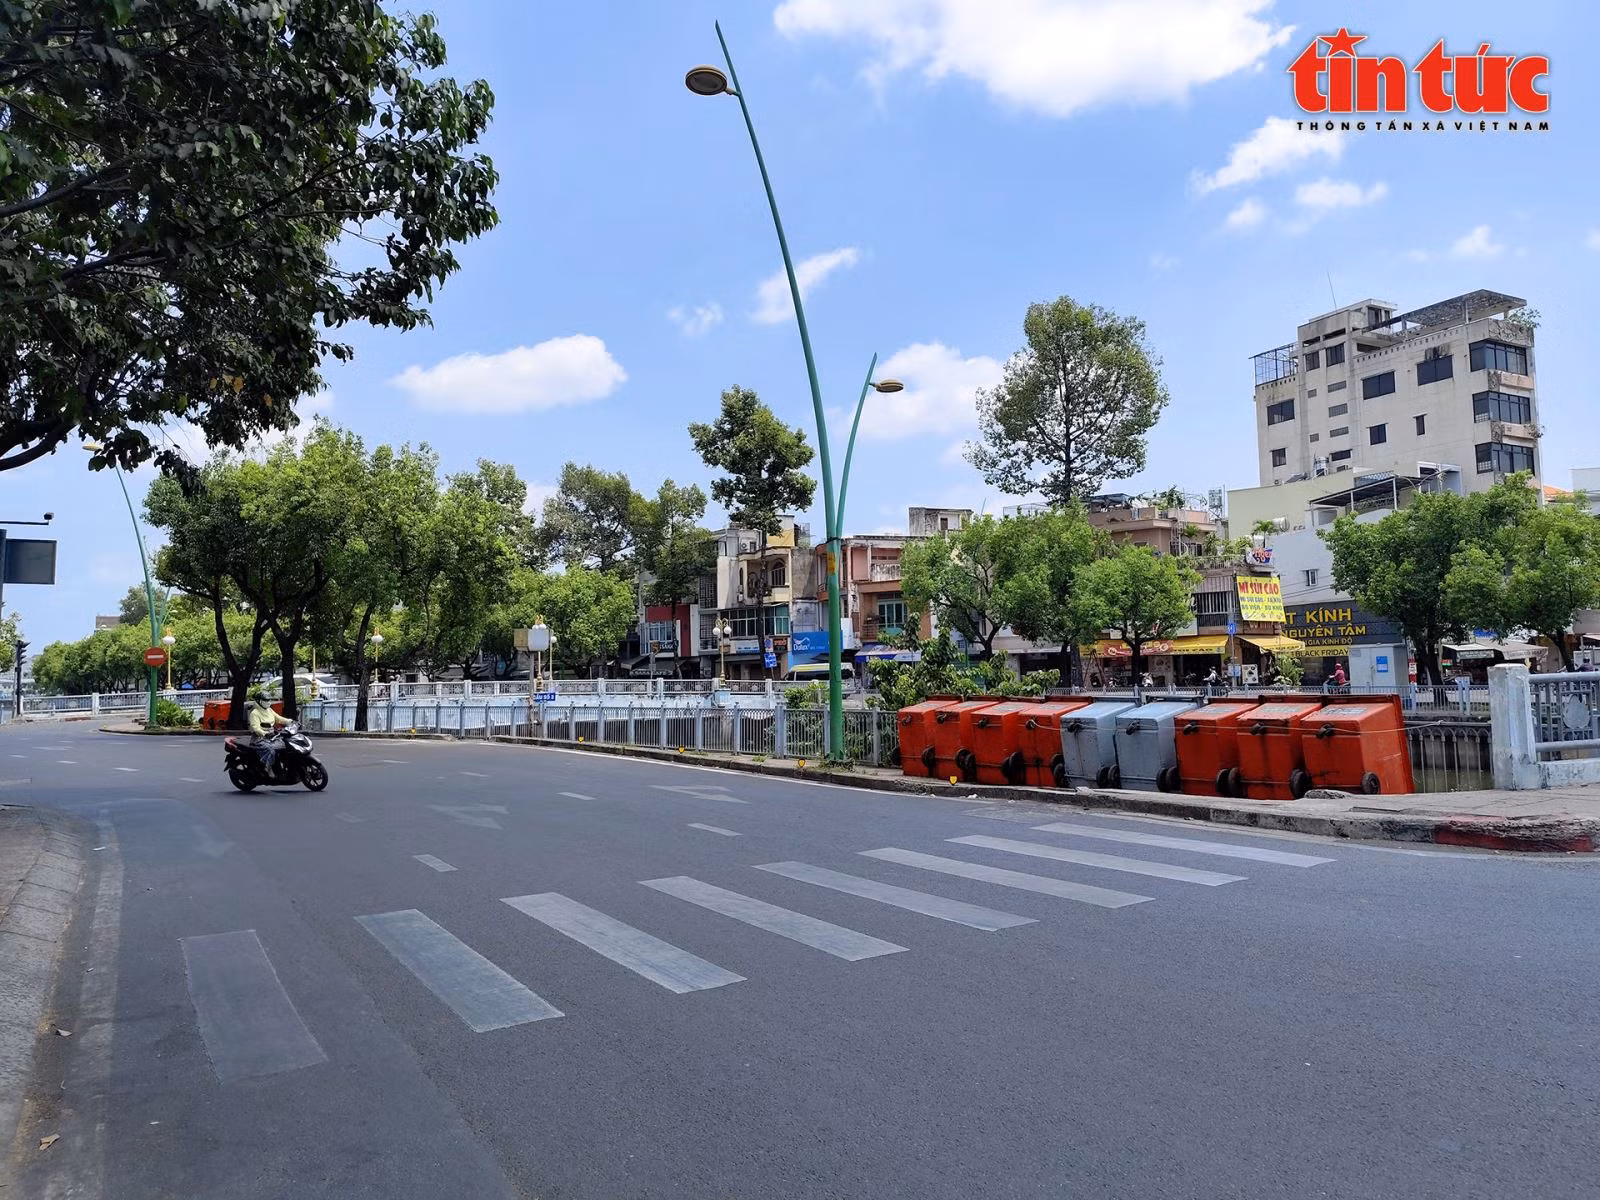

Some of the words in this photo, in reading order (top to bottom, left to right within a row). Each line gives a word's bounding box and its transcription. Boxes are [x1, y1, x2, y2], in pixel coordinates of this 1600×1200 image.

[1305, 607, 1351, 623] KÍNH
[1338, 622, 1366, 636] TÂM
[1295, 649, 1320, 657] BLACK
[1321, 648, 1349, 656] FRIDAY
